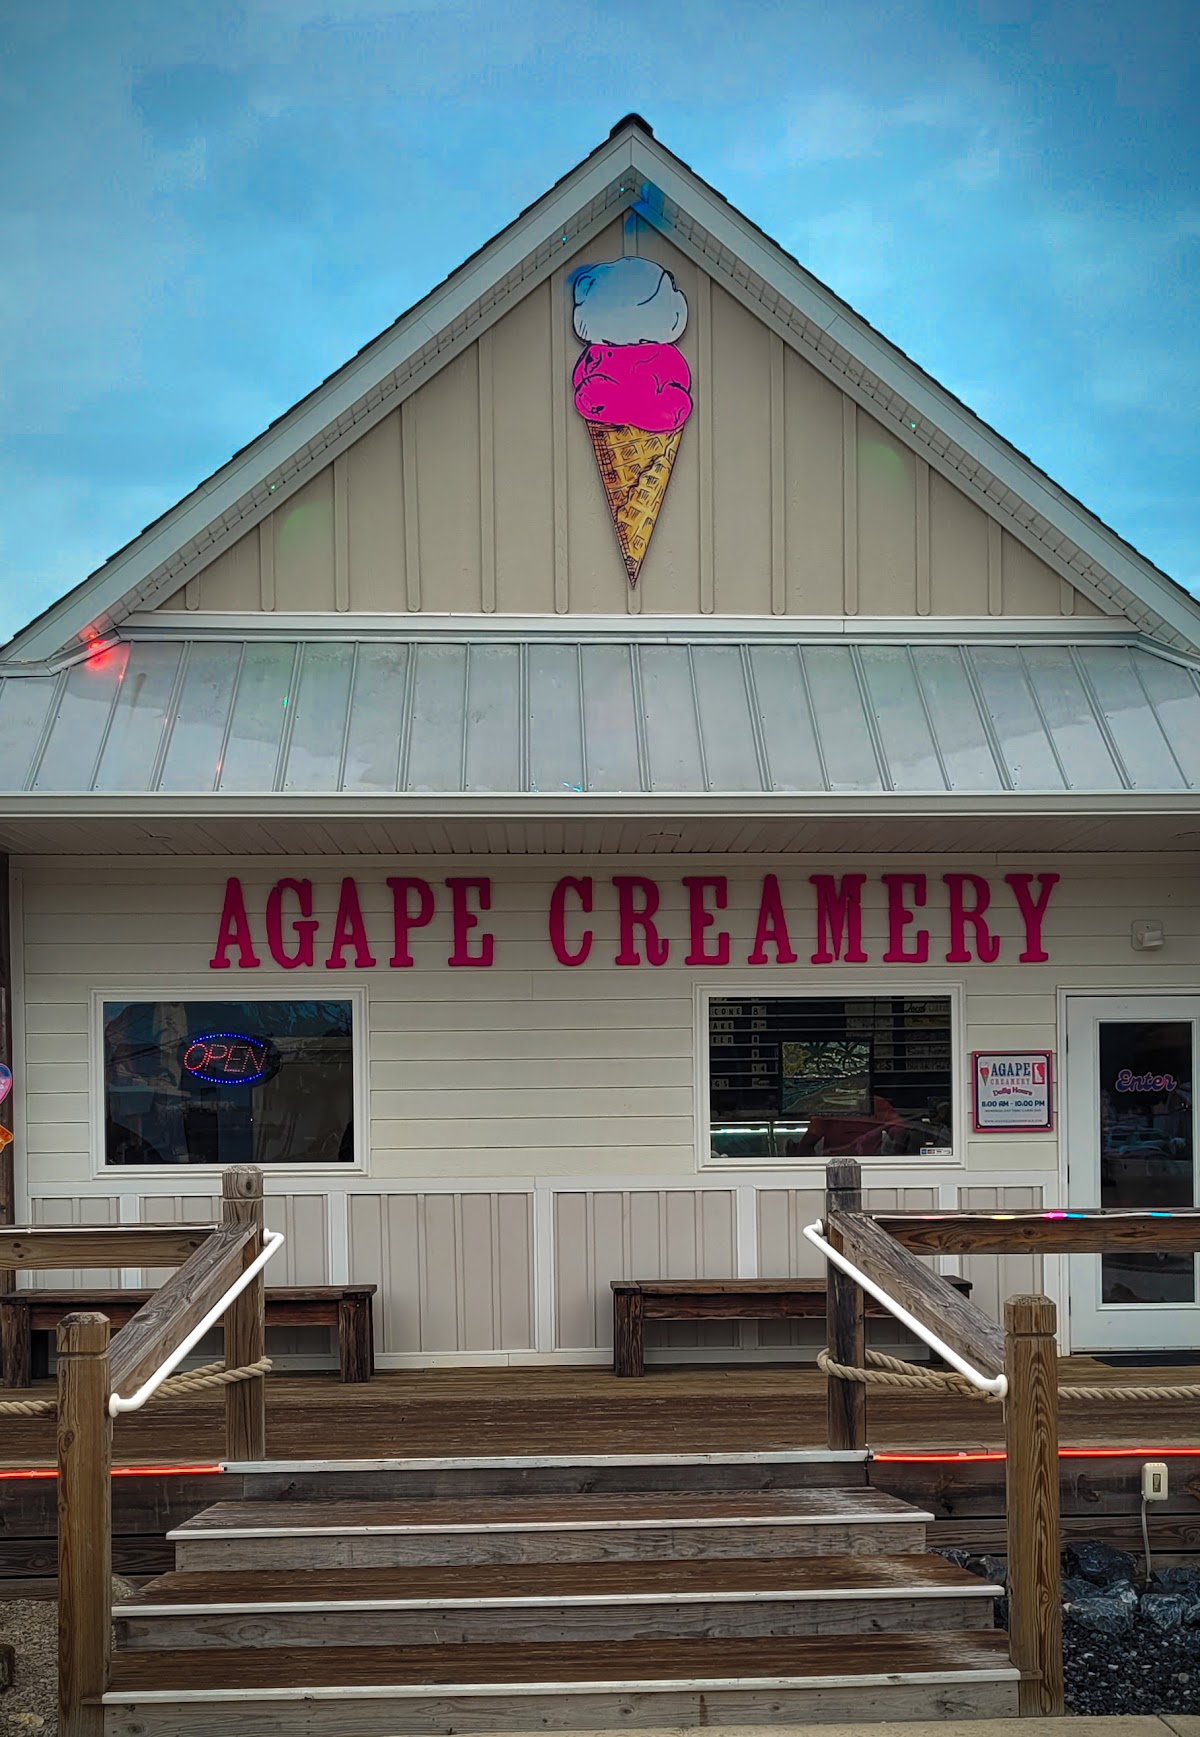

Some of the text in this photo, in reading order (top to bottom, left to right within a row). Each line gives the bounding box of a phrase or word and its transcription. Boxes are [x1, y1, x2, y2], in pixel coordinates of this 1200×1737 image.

[209, 873, 1060, 969] AGAPE CREAMERY
[183, 1043, 269, 1074] OPEN
[991, 1062, 1031, 1077] AGAPE
[992, 1086, 1033, 1097] Daily Hours
[1115, 1069, 1178, 1093] Enter
